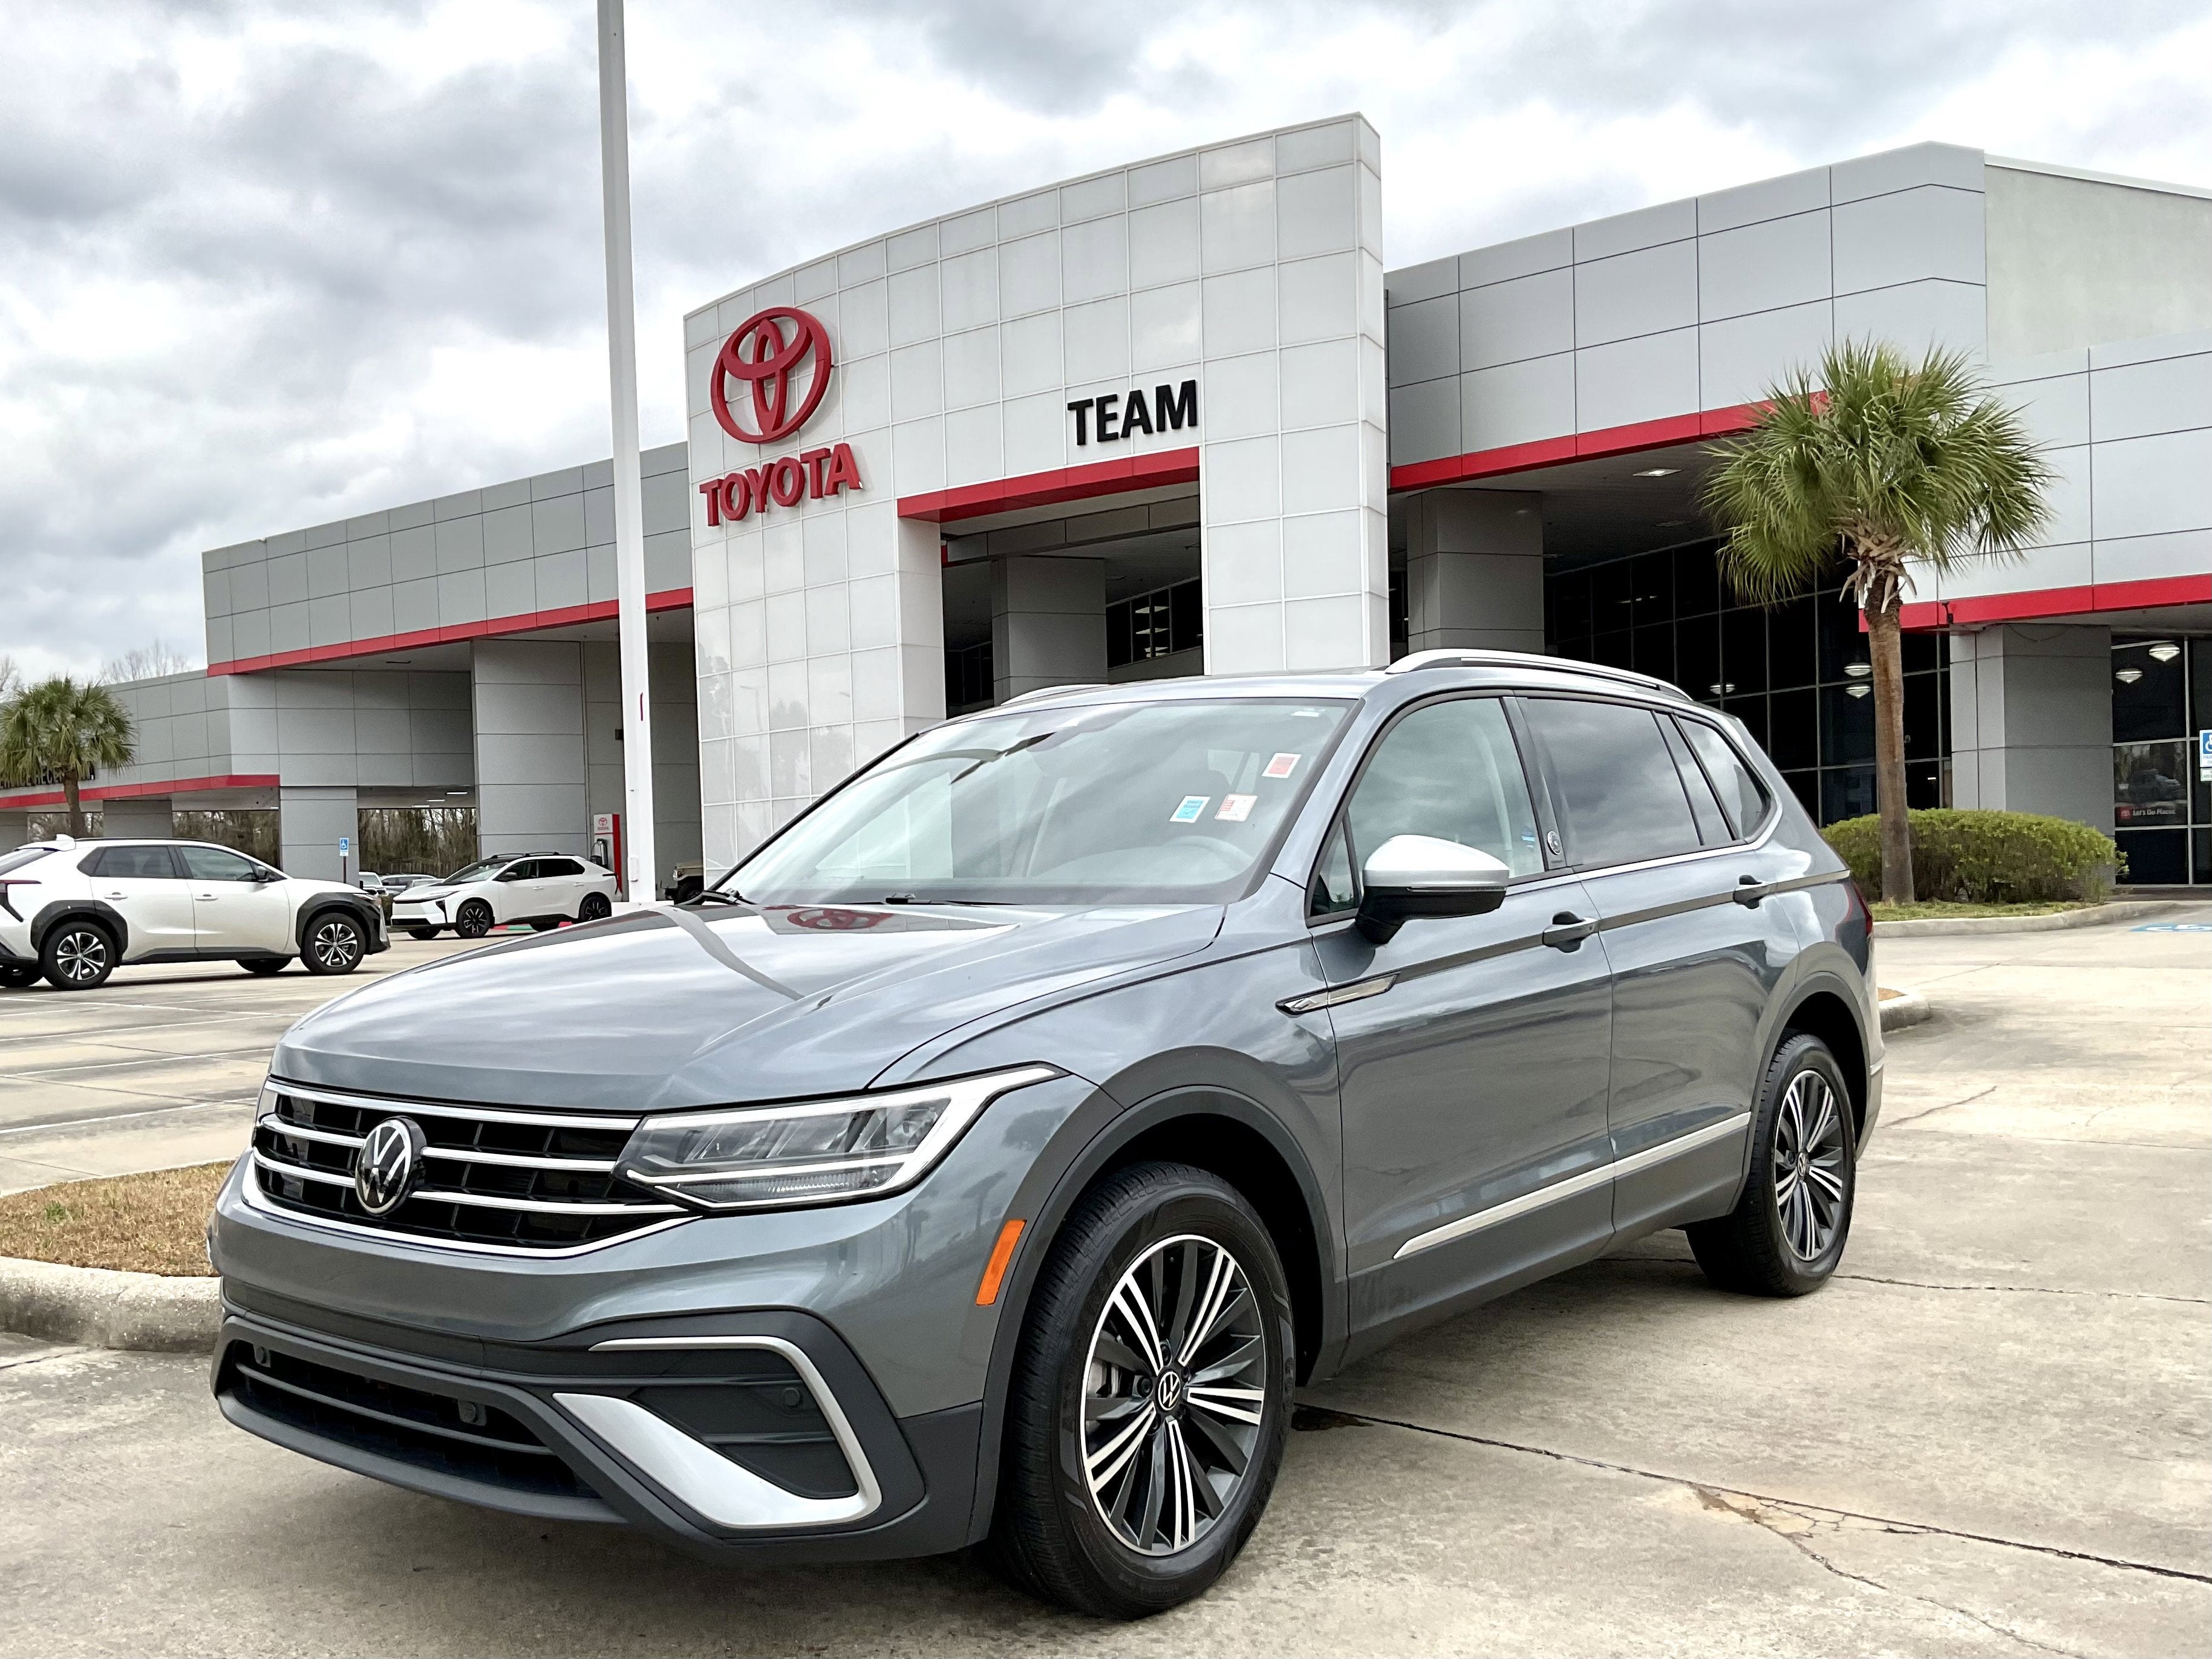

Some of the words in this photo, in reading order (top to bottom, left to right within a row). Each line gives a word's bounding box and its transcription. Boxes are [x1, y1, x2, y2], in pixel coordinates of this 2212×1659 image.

[1067, 379, 1198, 446] TEAM
[699, 443, 863, 527] TOYOTA
[359, 1122, 409, 1208] VW
[1160, 1372, 1180, 1410] VW
